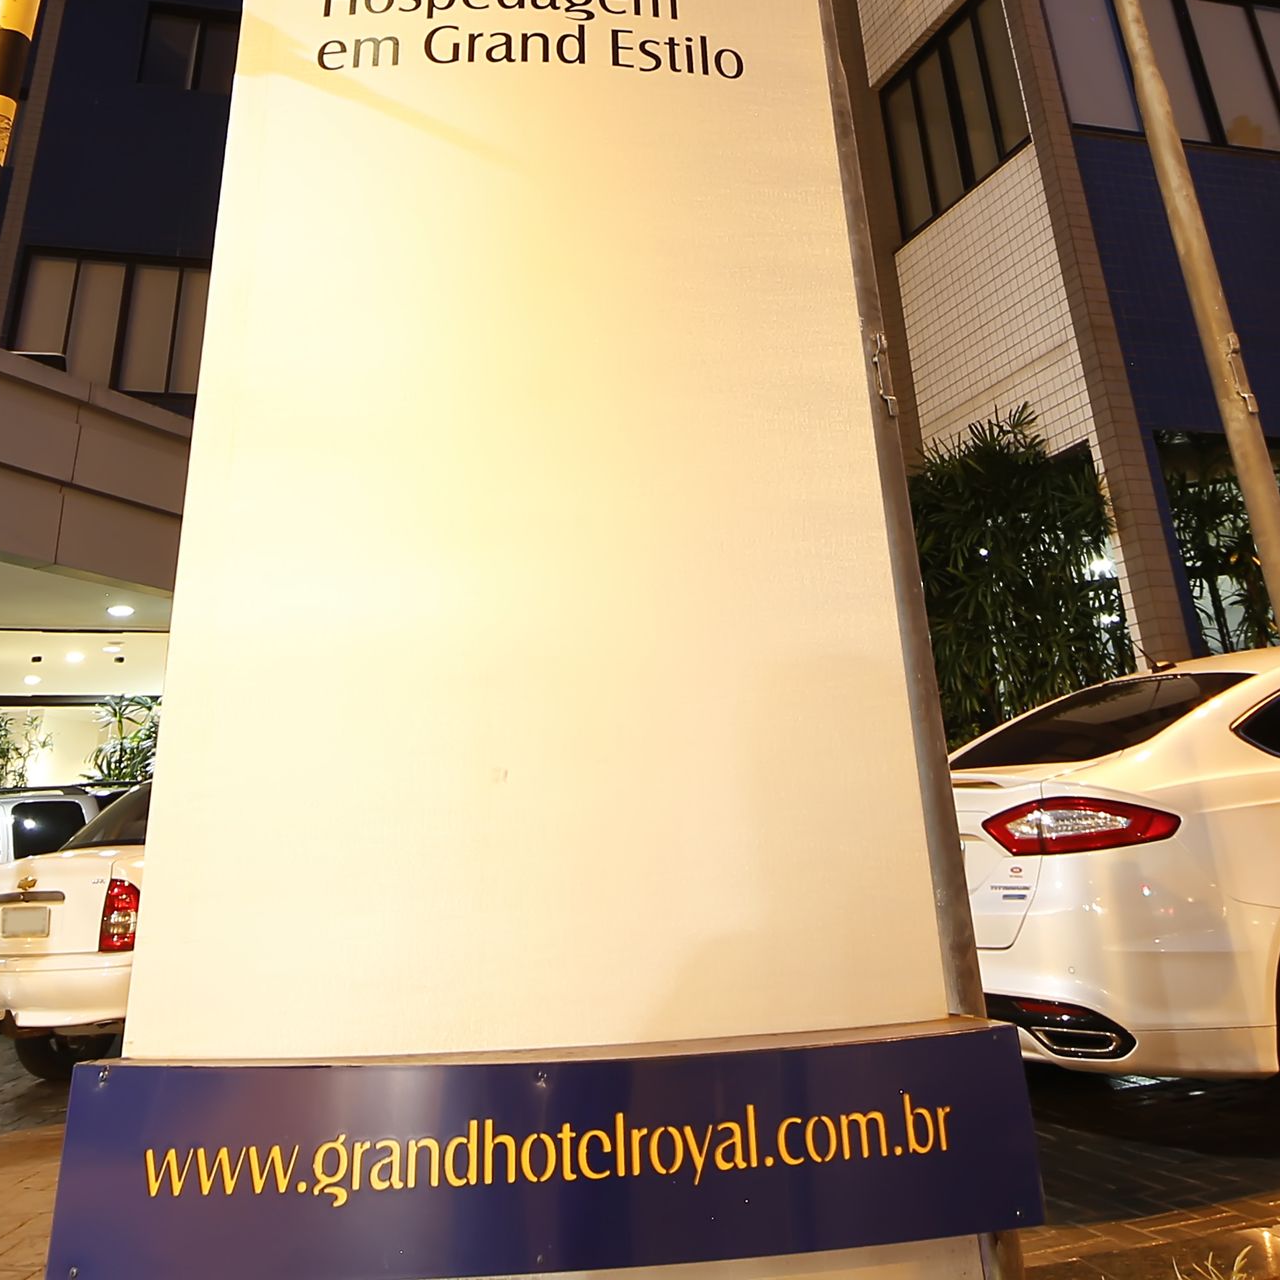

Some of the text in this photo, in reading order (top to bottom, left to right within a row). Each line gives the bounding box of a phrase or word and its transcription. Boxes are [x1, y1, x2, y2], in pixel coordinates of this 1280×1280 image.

[317, 24, 744, 80] em Grand Estilo
[144, 1093, 952, 1208] www.grandhotelroyal.com.br
